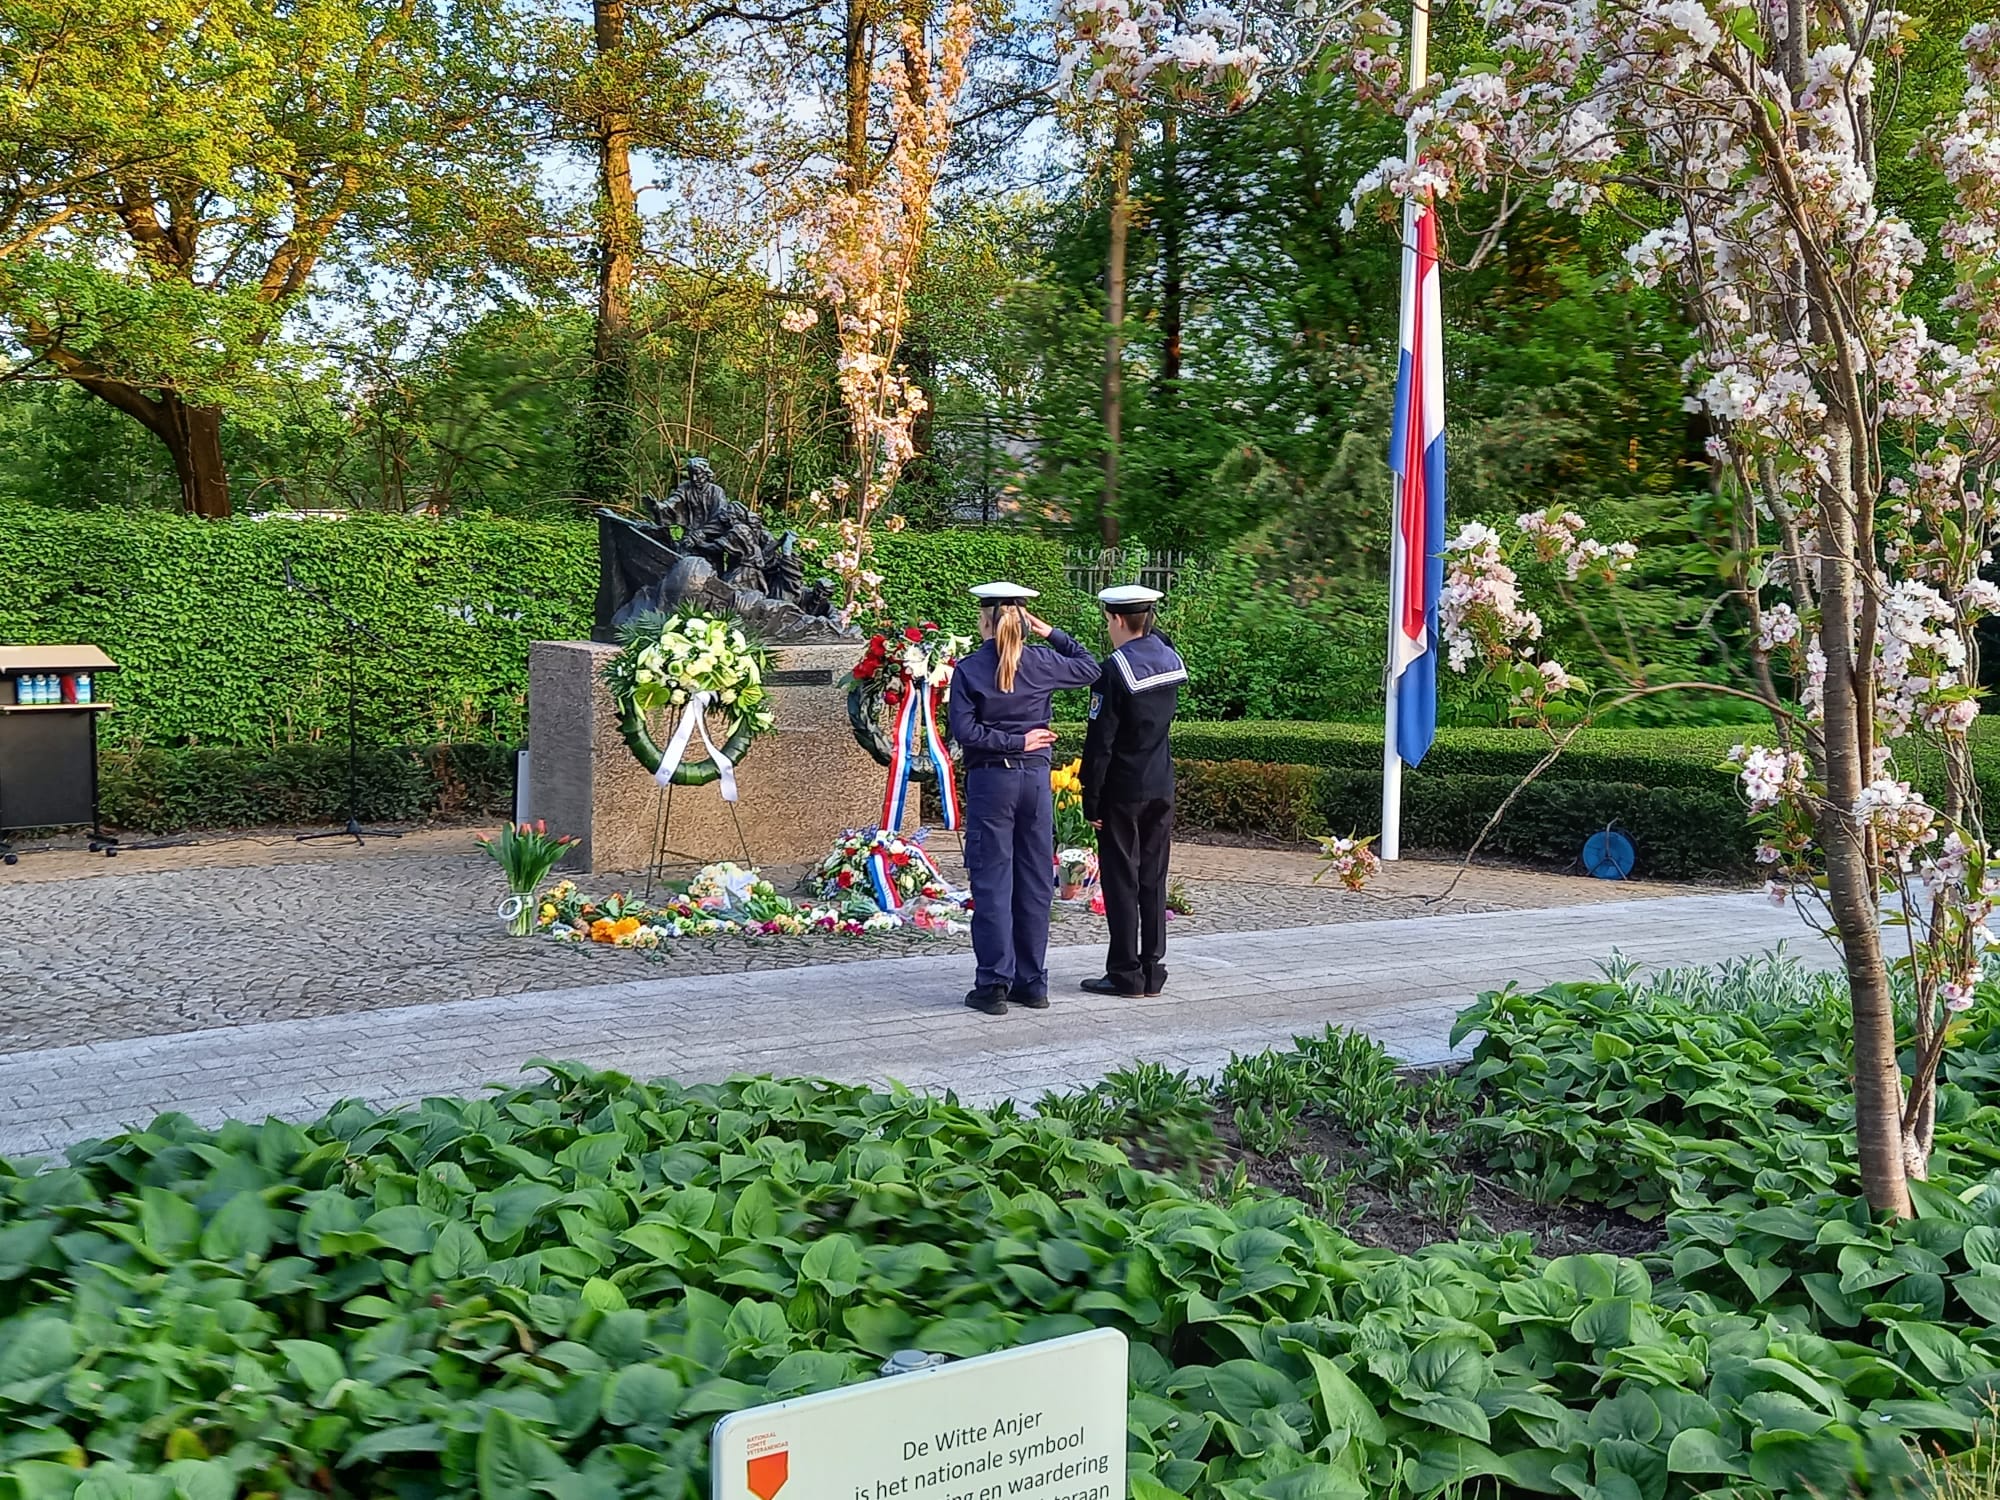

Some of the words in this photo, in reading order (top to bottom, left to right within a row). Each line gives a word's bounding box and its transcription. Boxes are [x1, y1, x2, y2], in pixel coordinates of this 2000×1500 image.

[903, 1441, 929, 1461] De
[935, 1426, 987, 1452] Witte
[993, 1412, 1042, 1436] Anjer
[876, 1476, 908, 1500] het
[914, 1450, 1003, 1490] nationale
[1008, 1426, 1084, 1466] symbool
[979, 1484, 1002, 1500] en
[1008, 1455, 1109, 1494] waardering
